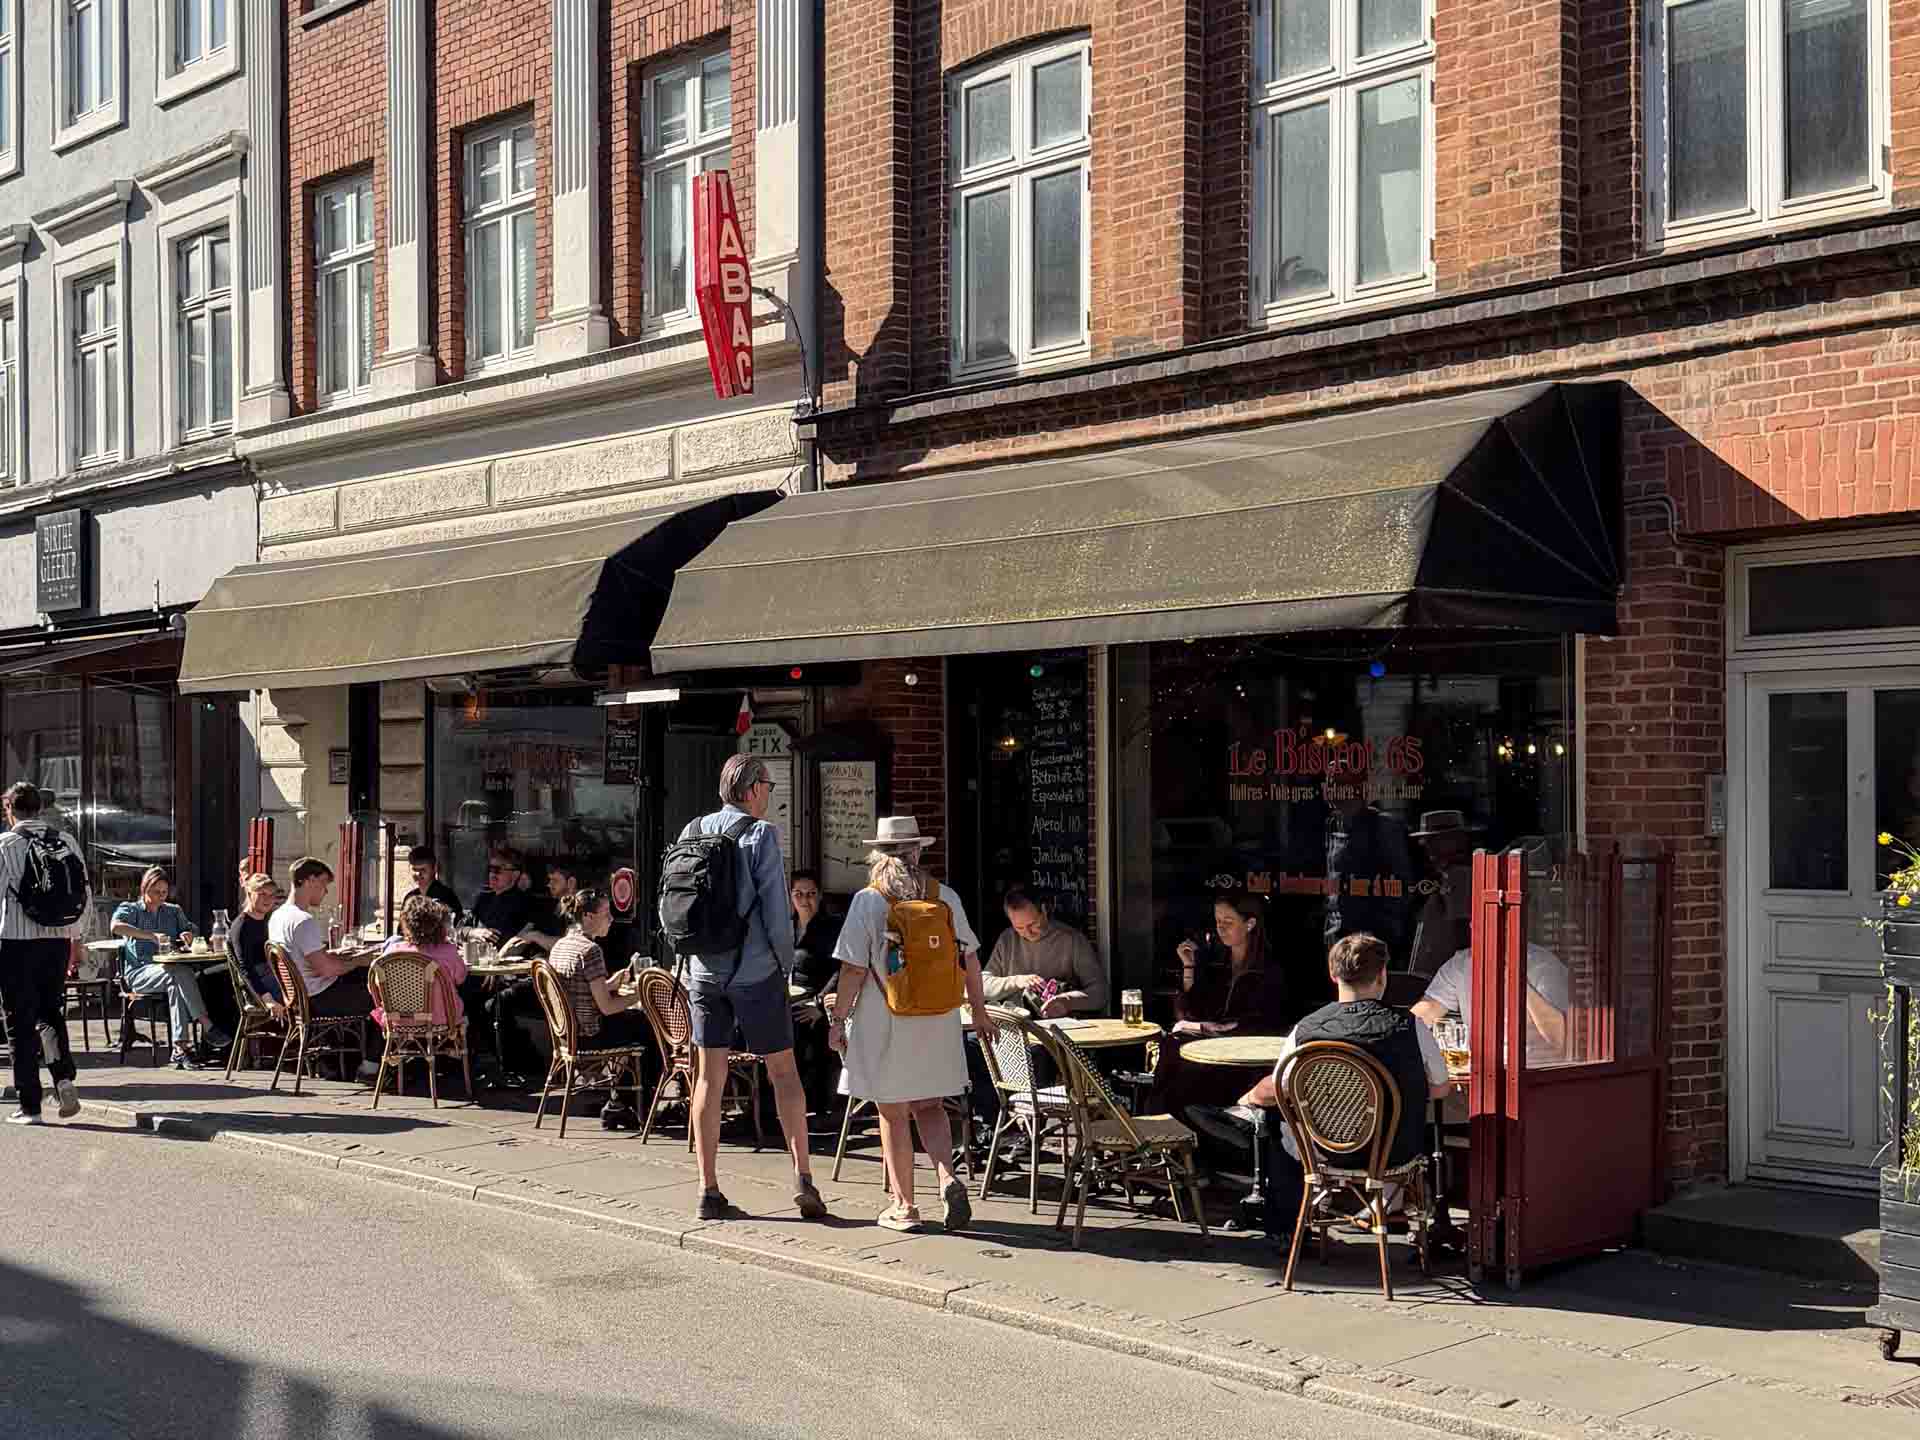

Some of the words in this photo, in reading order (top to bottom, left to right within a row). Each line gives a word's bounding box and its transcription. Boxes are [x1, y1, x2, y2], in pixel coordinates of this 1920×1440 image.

[717, 171, 751, 392] TABAC
[43, 522, 73, 553] BIRTHE
[749, 737, 781, 753] FIX
[1226, 741, 1267, 777] Le
[1273, 727, 1376, 777] Bistrot
